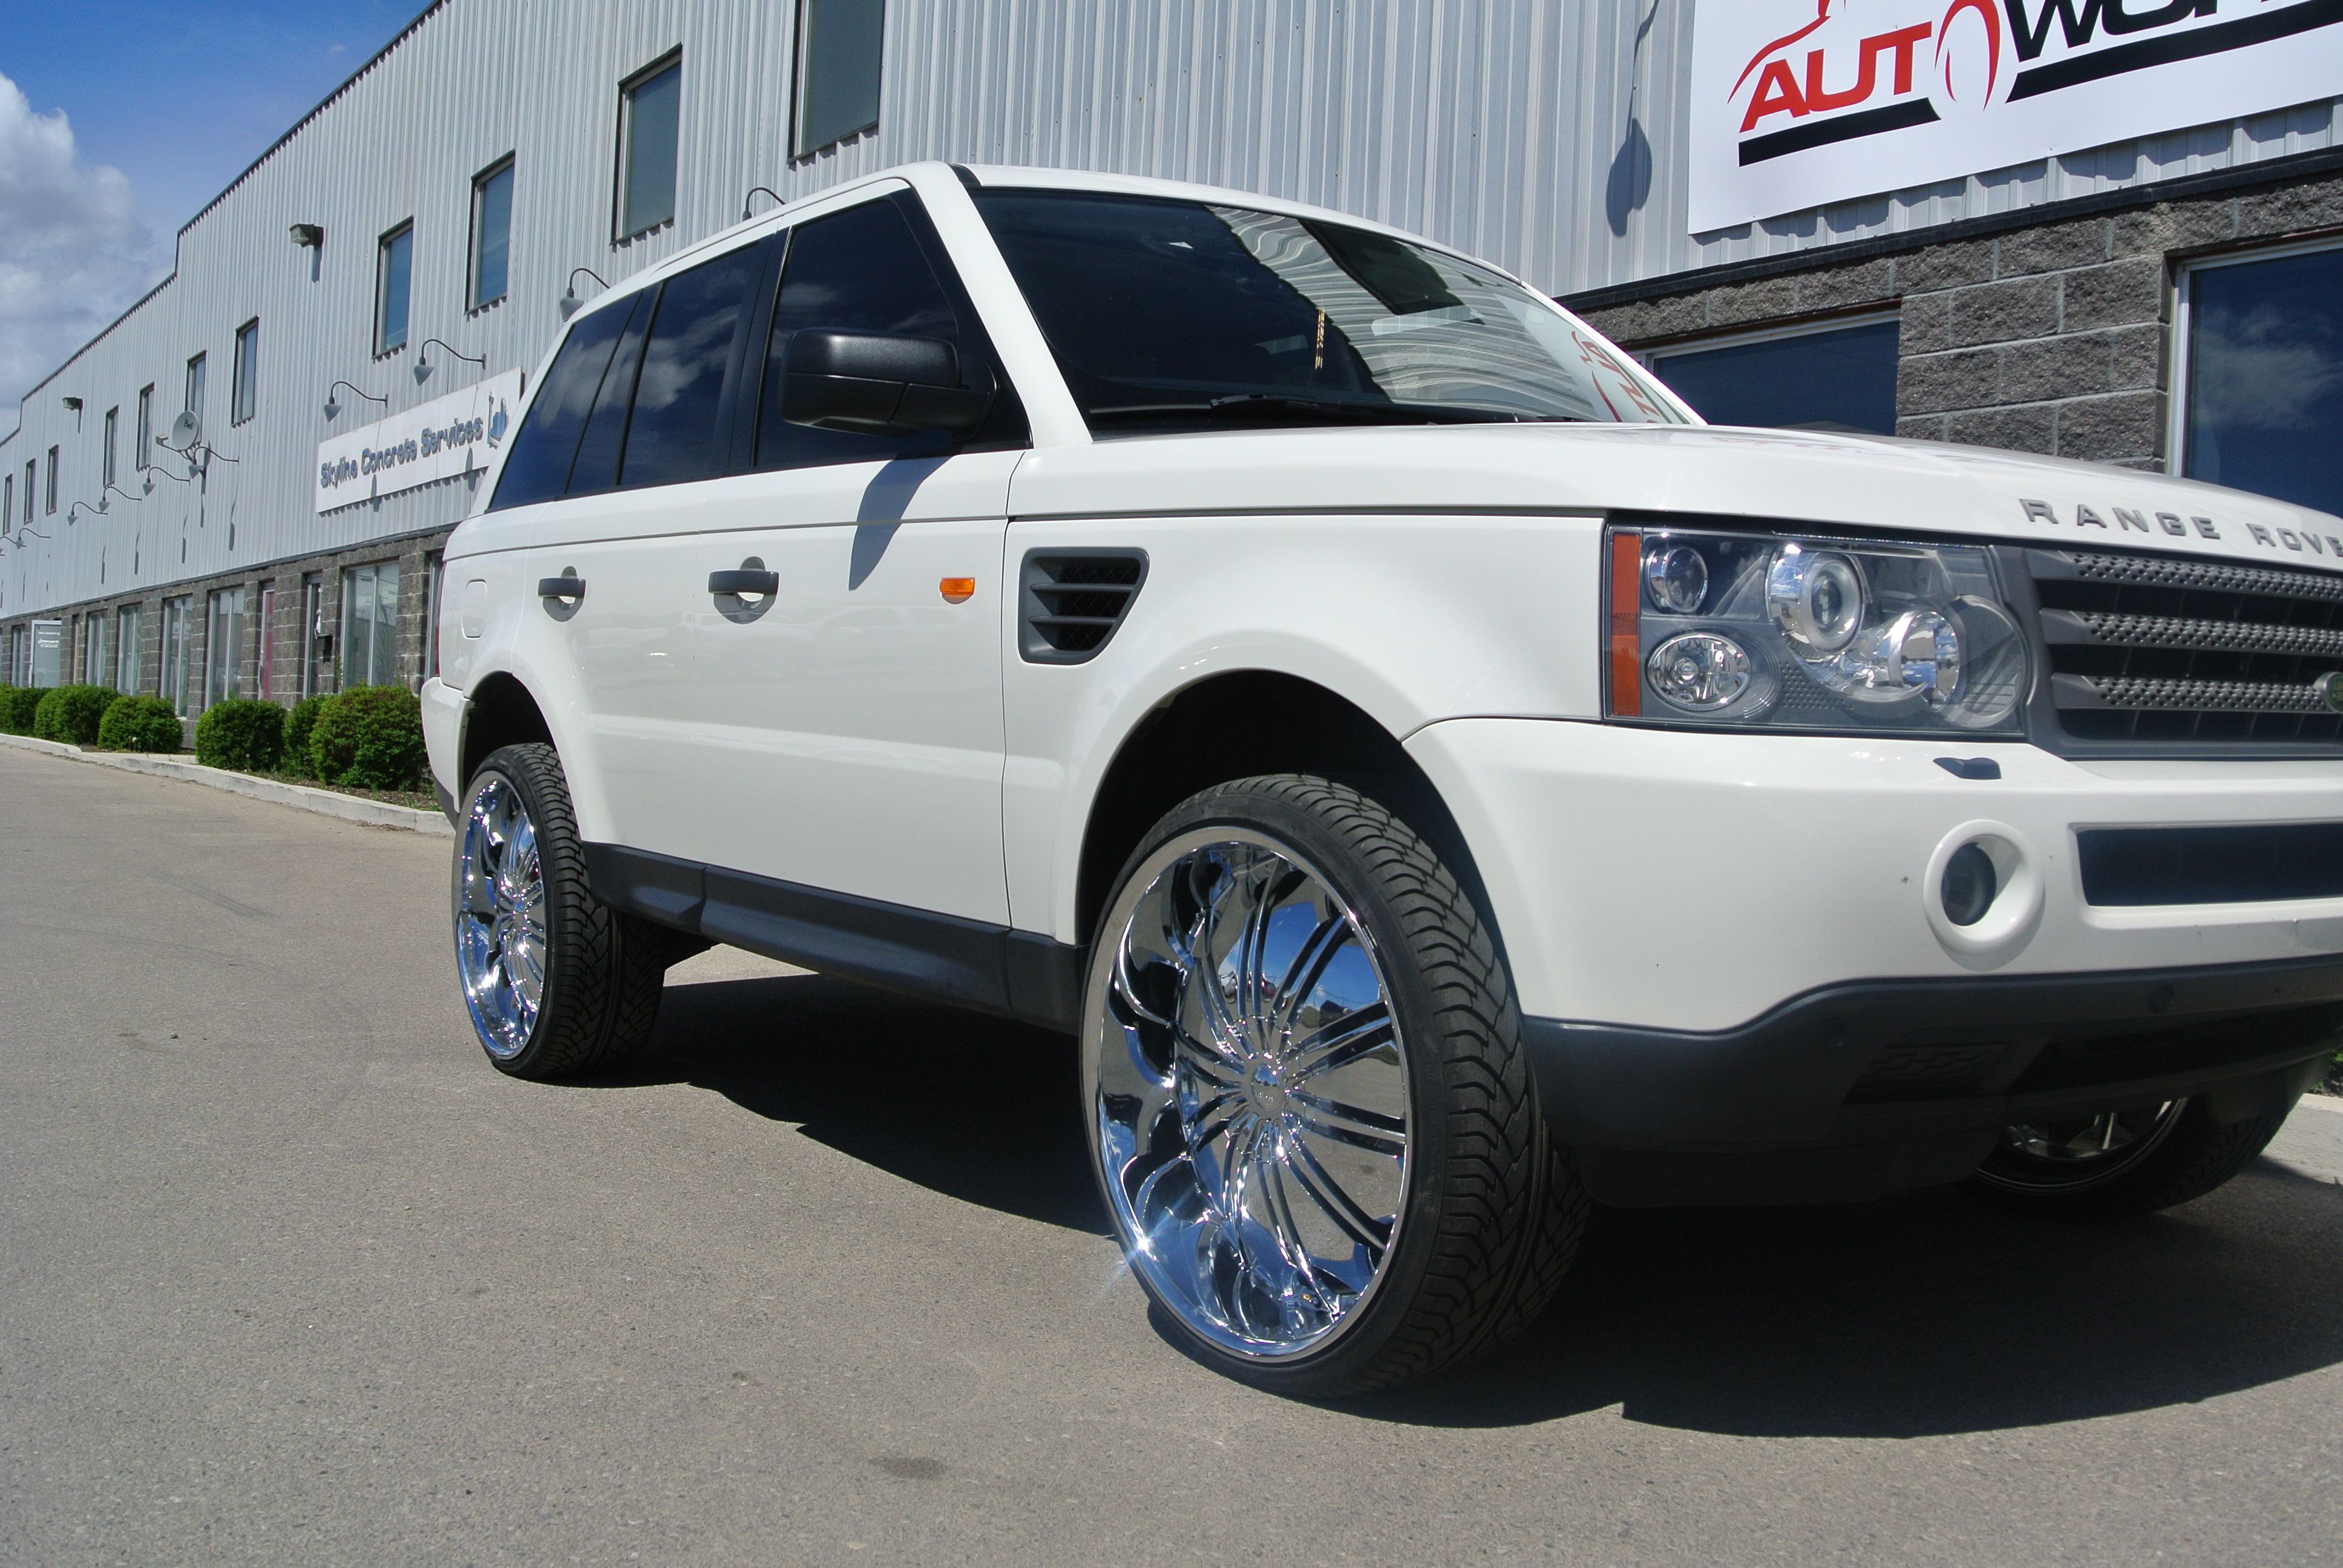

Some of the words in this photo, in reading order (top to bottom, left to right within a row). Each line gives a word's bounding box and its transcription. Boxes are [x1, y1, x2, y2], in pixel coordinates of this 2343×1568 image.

[321, 456, 358, 489] Skyline
[361, 438, 418, 475] Concrete
[421, 417, 483, 457] Services
[2019, 498, 2220, 540] RANGE
